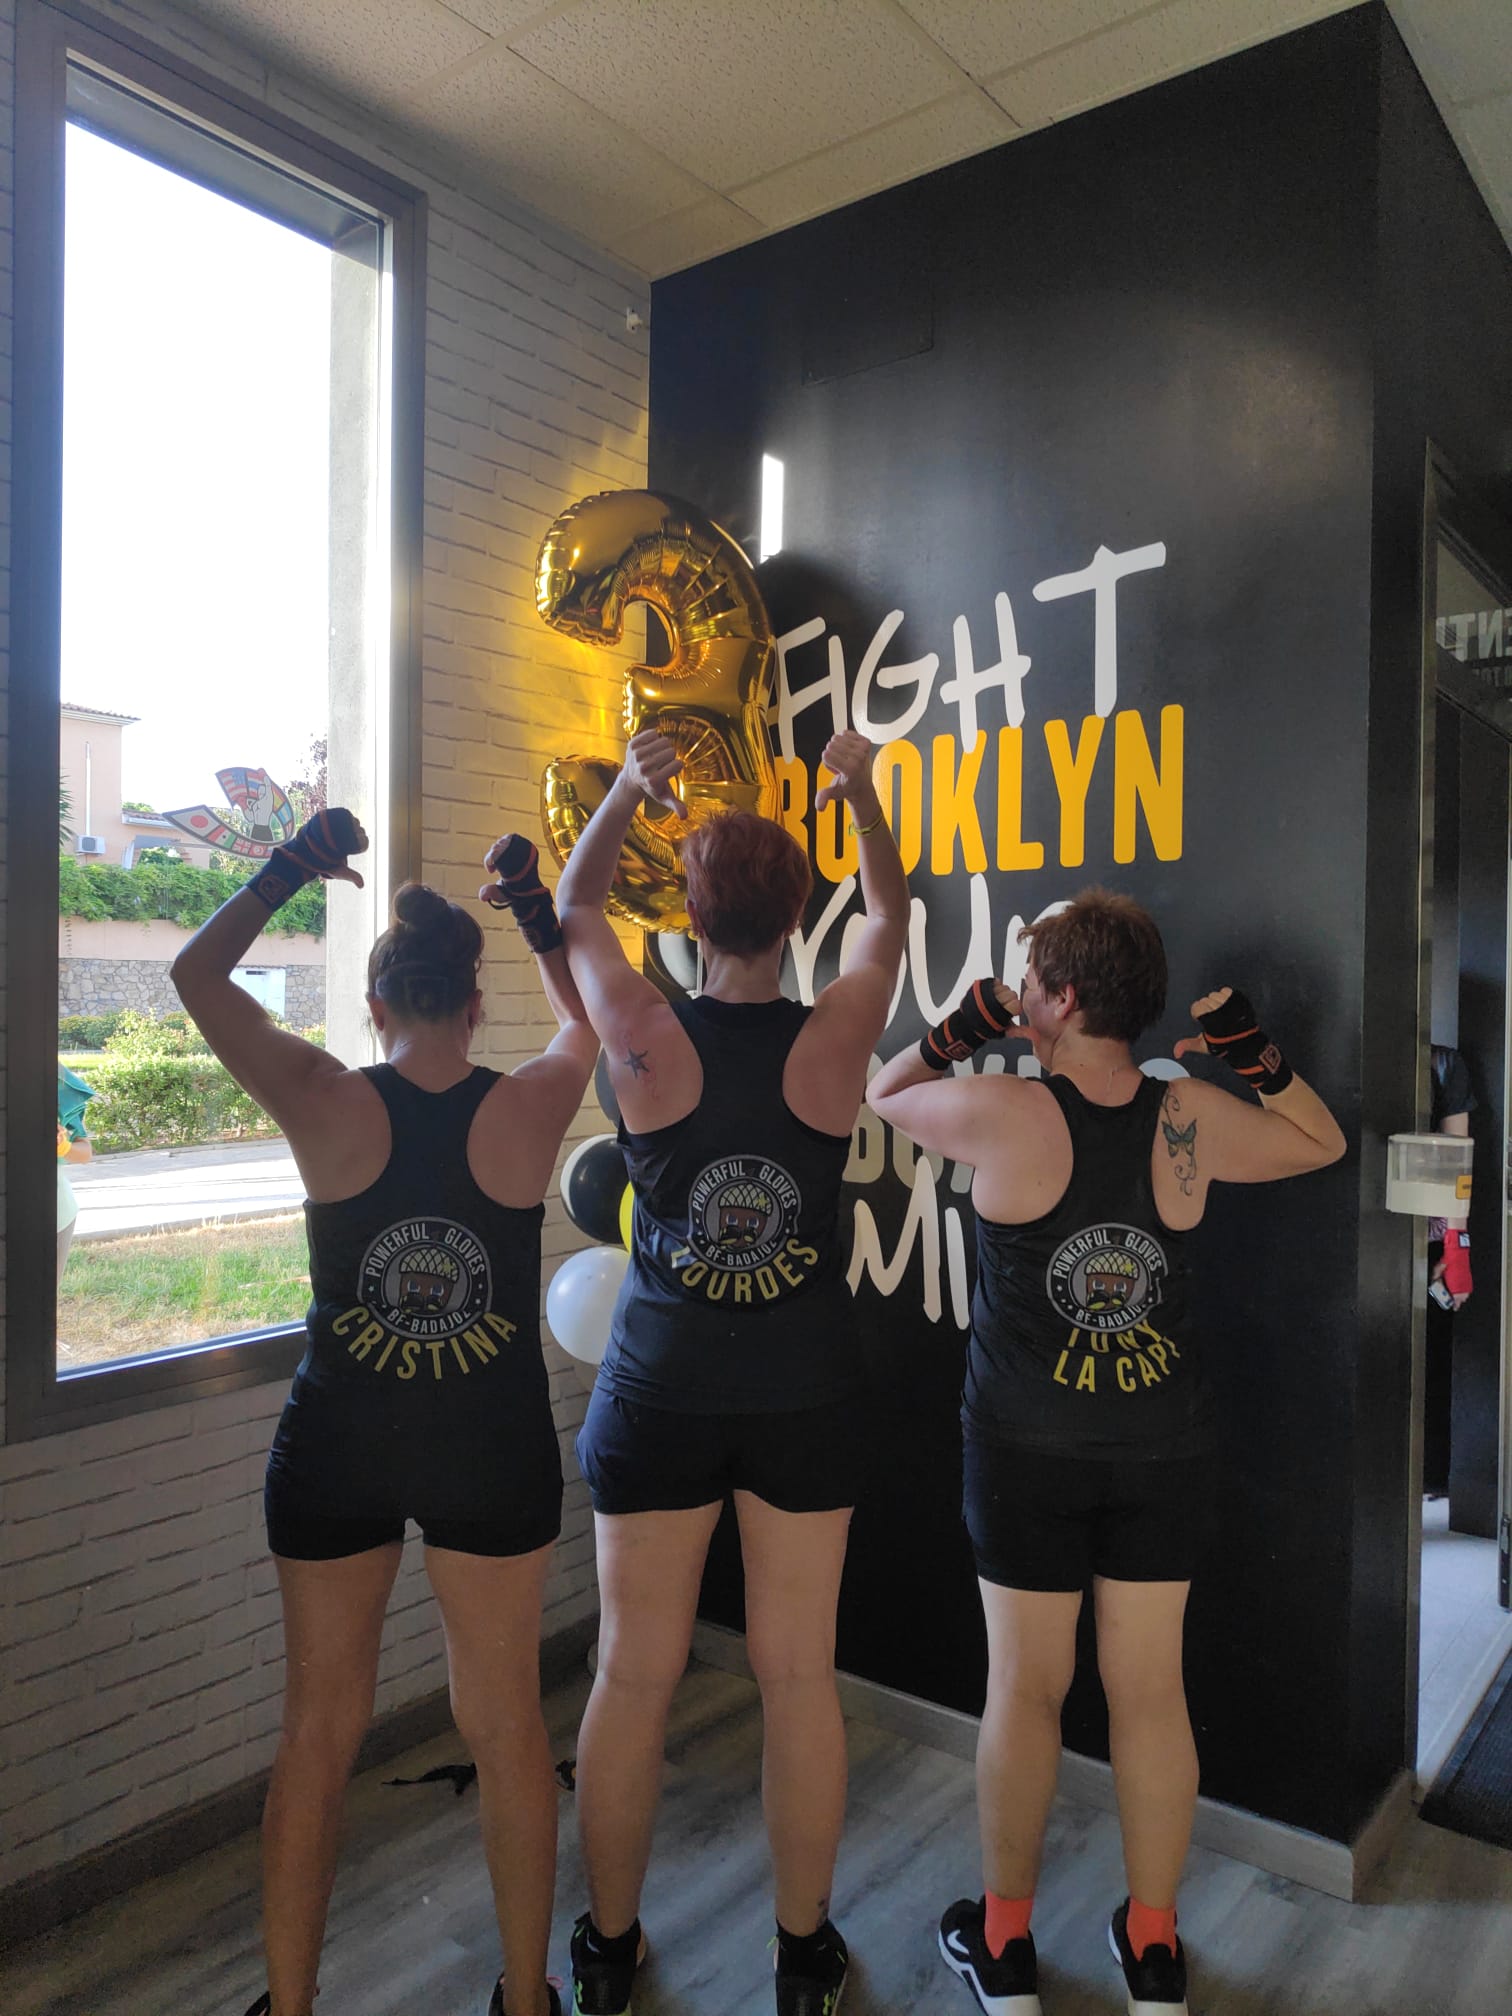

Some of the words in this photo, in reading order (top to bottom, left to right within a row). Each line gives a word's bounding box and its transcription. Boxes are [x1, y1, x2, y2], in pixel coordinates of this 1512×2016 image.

[768, 541, 1166, 764] FIGHT
[773, 704, 1184, 884] ROOKLYN
[691, 1160, 746, 1212] POWERFUL
[759, 1164, 797, 1210] GLOVES
[365, 1222, 430, 1278] POWERFUL
[444, 1227, 486, 1276] GLOVES
[671, 1237, 819, 1303] LOURDES
[1052, 1228, 1111, 1280] POWERFUL
[1124, 1232, 1163, 1272] GLOVES
[332, 1306, 518, 1381] CRISTINA
[1075, 1304, 1146, 1329] BF-BADAJO
[1053, 1350, 1096, 1393] LA
